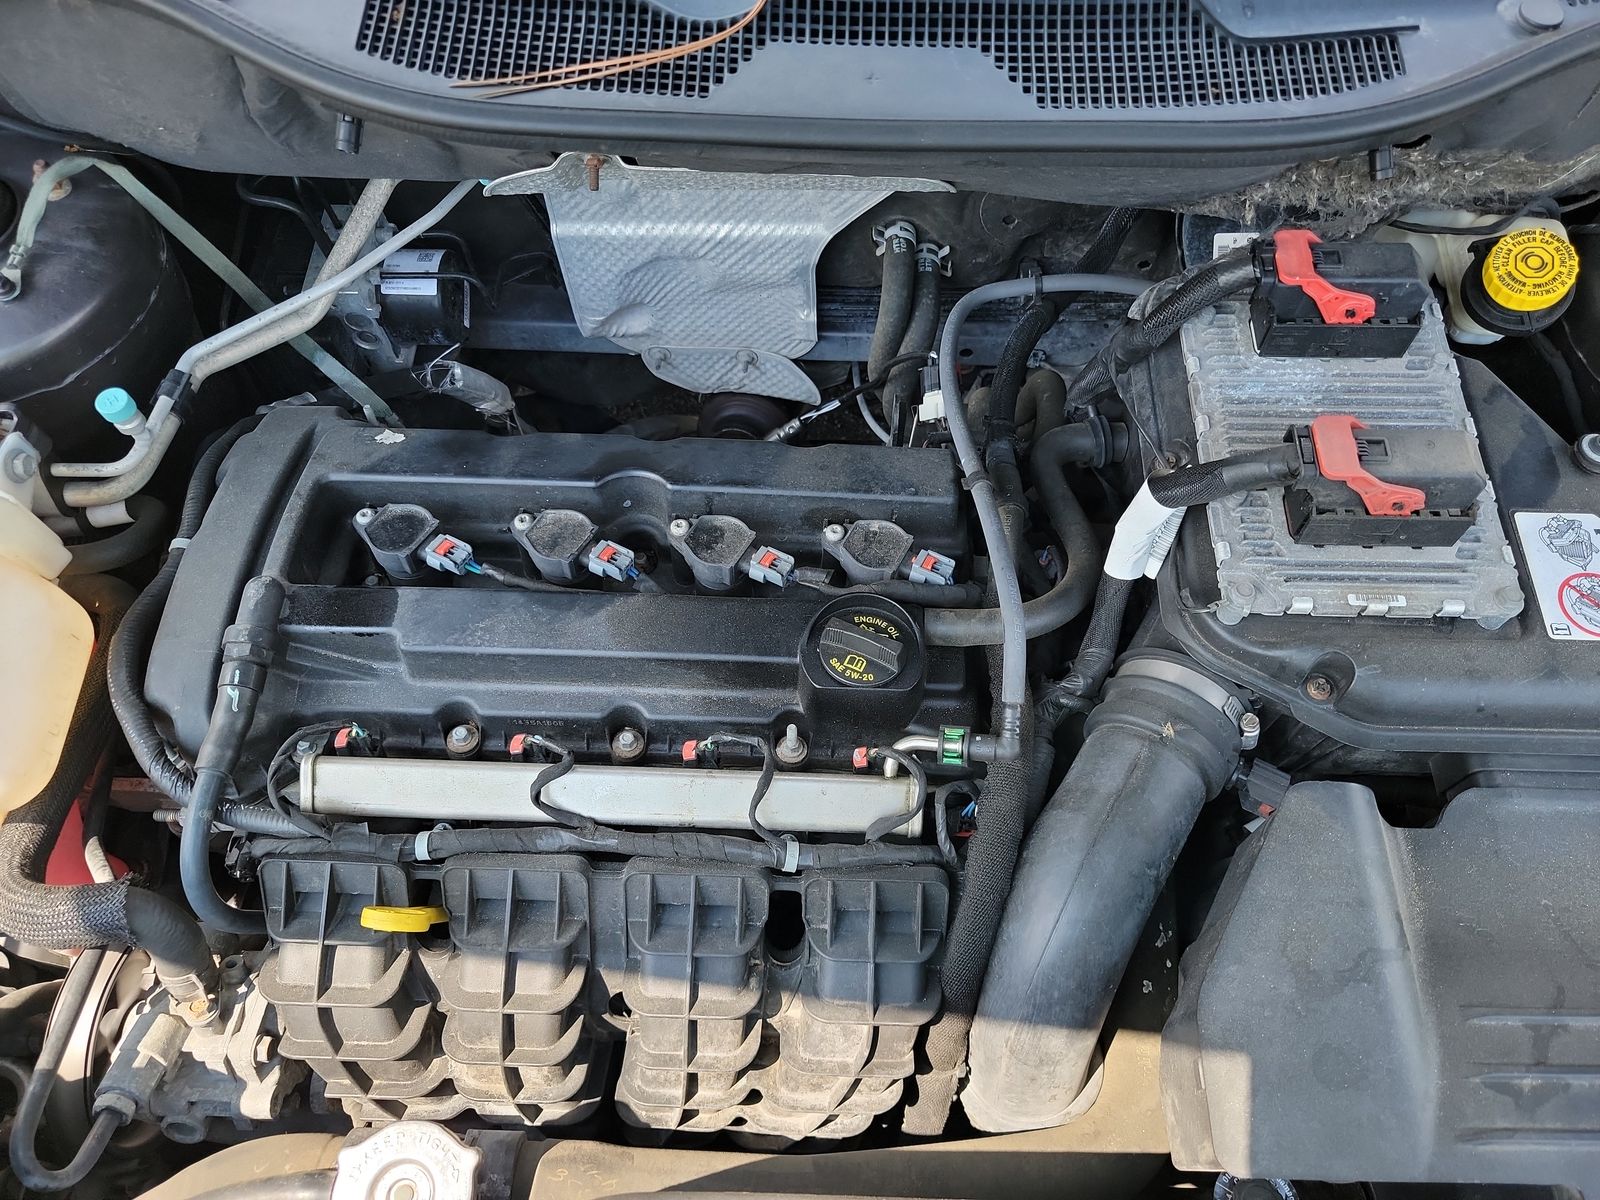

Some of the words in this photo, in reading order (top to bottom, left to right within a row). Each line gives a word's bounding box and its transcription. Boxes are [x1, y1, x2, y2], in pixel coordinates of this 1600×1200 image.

[1512, 237, 1537, 248] FILLER
[1540, 237, 1555, 246] CAP
[1493, 246, 1504, 272] NETTOYER
[1502, 239, 1510, 247] LE
[1510, 230, 1537, 240] BOUCHON
[1549, 233, 1576, 261] REMPLISSAGE
[1566, 263, 1576, 280] AVANT
[1502, 248, 1514, 267] CLEAN
[1554, 246, 1567, 269] BEFORE
[1507, 270, 1527, 288] WARNING
[1533, 270, 1565, 290] REMOVING
[854, 616, 888, 628] ENGINE
[887, 626, 899, 639] OIL
[829, 657, 846, 673] SAE
[844, 670, 874, 681] 5W-20
